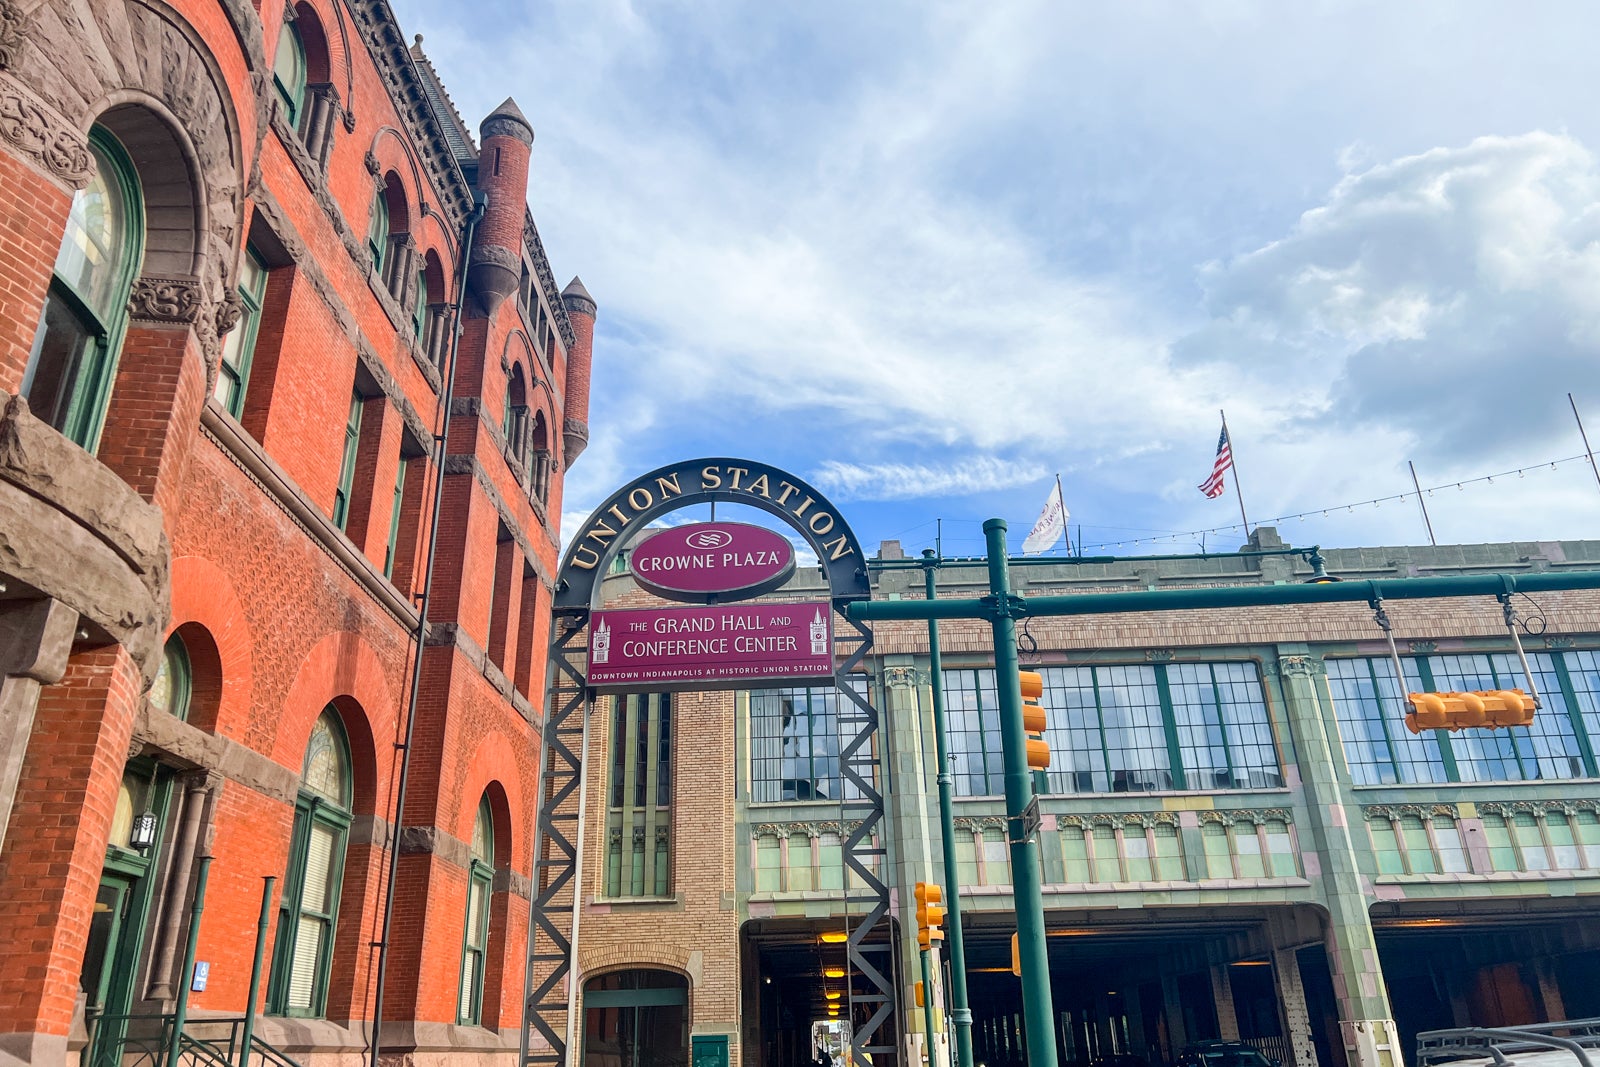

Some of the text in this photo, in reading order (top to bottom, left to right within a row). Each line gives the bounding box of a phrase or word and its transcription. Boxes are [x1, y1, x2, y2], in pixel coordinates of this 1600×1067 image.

[570, 466, 855, 570] UNION STATION
[639, 551, 780, 572] CROWNE PLAZA
[629, 614, 791, 634] THE GRAND HALL AND
[623, 636, 798, 658] CONFERENCE CENTER
[591, 672, 639, 680] DOWNTOWN
[642, 669, 703, 678] INDIANAPOLIS
